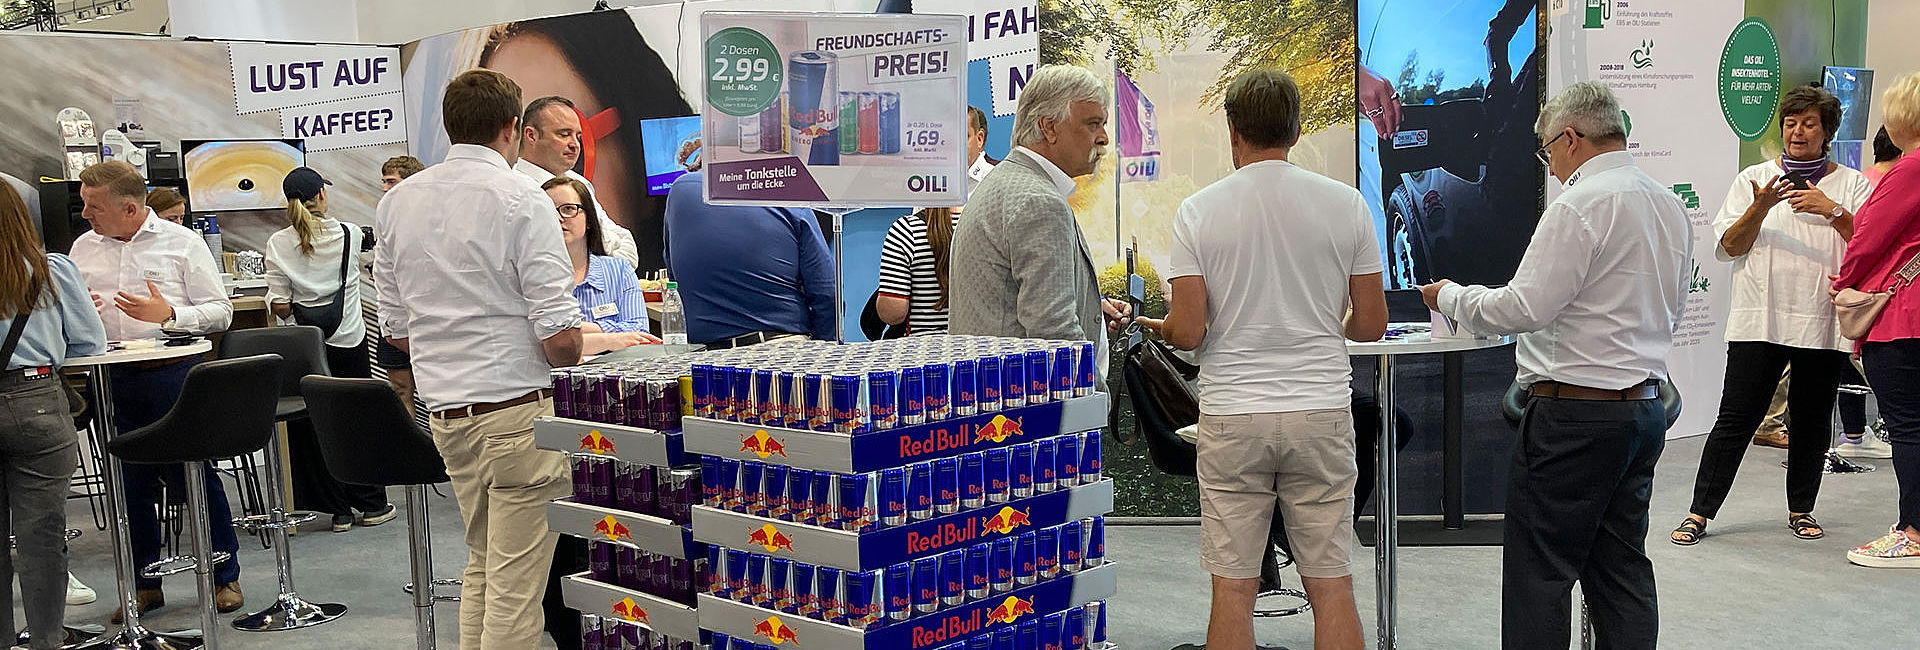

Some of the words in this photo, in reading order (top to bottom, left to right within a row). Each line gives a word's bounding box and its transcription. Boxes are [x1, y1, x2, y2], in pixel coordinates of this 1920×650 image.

[816, 28, 948, 50] FREUNDSCHAFTS-
[720, 45, 726, 54] 2
[729, 45, 759, 55] Dosen
[874, 50, 948, 78] PREIS!
[1744, 55, 1754, 64] DAS
[250, 62, 324, 93] LUST
[333, 57, 388, 87] AUF
[712, 58, 769, 82] 2,99
[1732, 68, 1768, 78] INSEKTENHOTEL
[1731, 80, 1741, 90] FÜR
[1742, 82, 1756, 90] MEHR
[1742, 96, 1762, 104] VIELFALT
[294, 109, 393, 138] KAFFEE?
[906, 130, 939, 146] 1,69
[720, 174, 742, 182] Meine
[744, 165, 797, 179] Tankstelle
[737, 182, 749, 191] um
[752, 181, 763, 189] die
[765, 179, 785, 188] Ecke.
[908, 175, 947, 192] OIL!
[986, 388, 1000, 397] Re
[1010, 384, 1024, 394] Re
[961, 392, 974, 401] Re
[908, 400, 923, 410] Re
[900, 430, 934, 458] Red
[937, 424, 968, 450] Bull
[1020, 474, 1032, 484] Re
[919, 495, 931, 506] Re
[908, 524, 942, 554] Red
[945, 517, 976, 545] Bull
[998, 568, 1011, 578] Re
[949, 582, 962, 591] Re
[912, 618, 946, 648] Red
[949, 608, 980, 639] Bull
